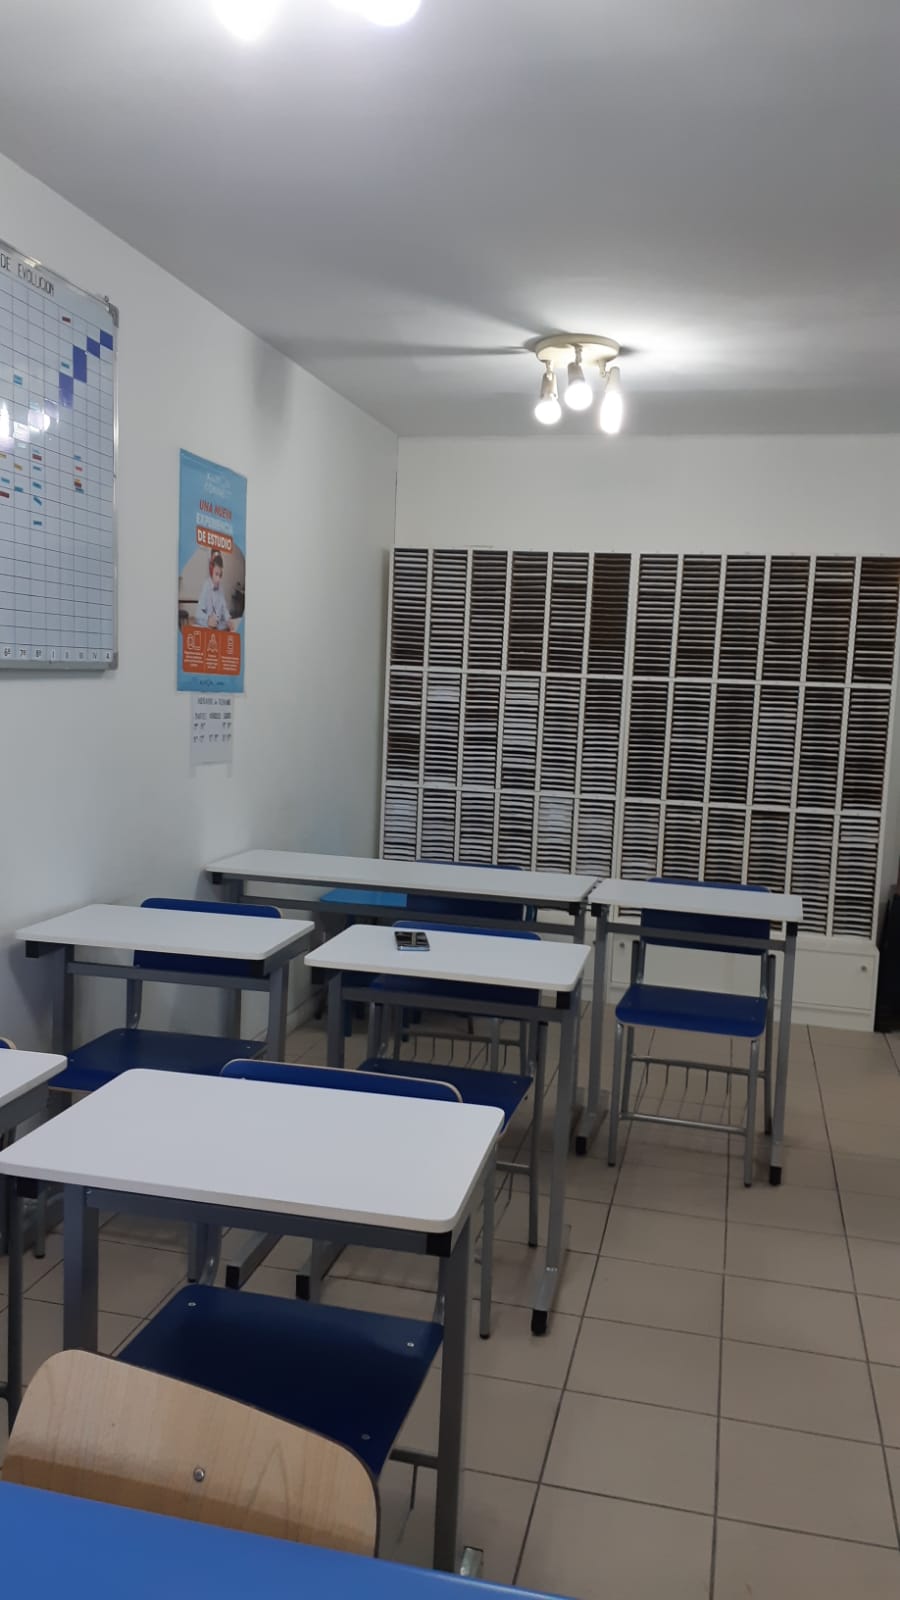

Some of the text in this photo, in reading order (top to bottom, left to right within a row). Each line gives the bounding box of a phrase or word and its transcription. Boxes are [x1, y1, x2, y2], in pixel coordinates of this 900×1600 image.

[1, 253, 11, 271] DE
[199, 499, 213, 513] UNA
[197, 527, 232, 551] DE ESTUDIO
